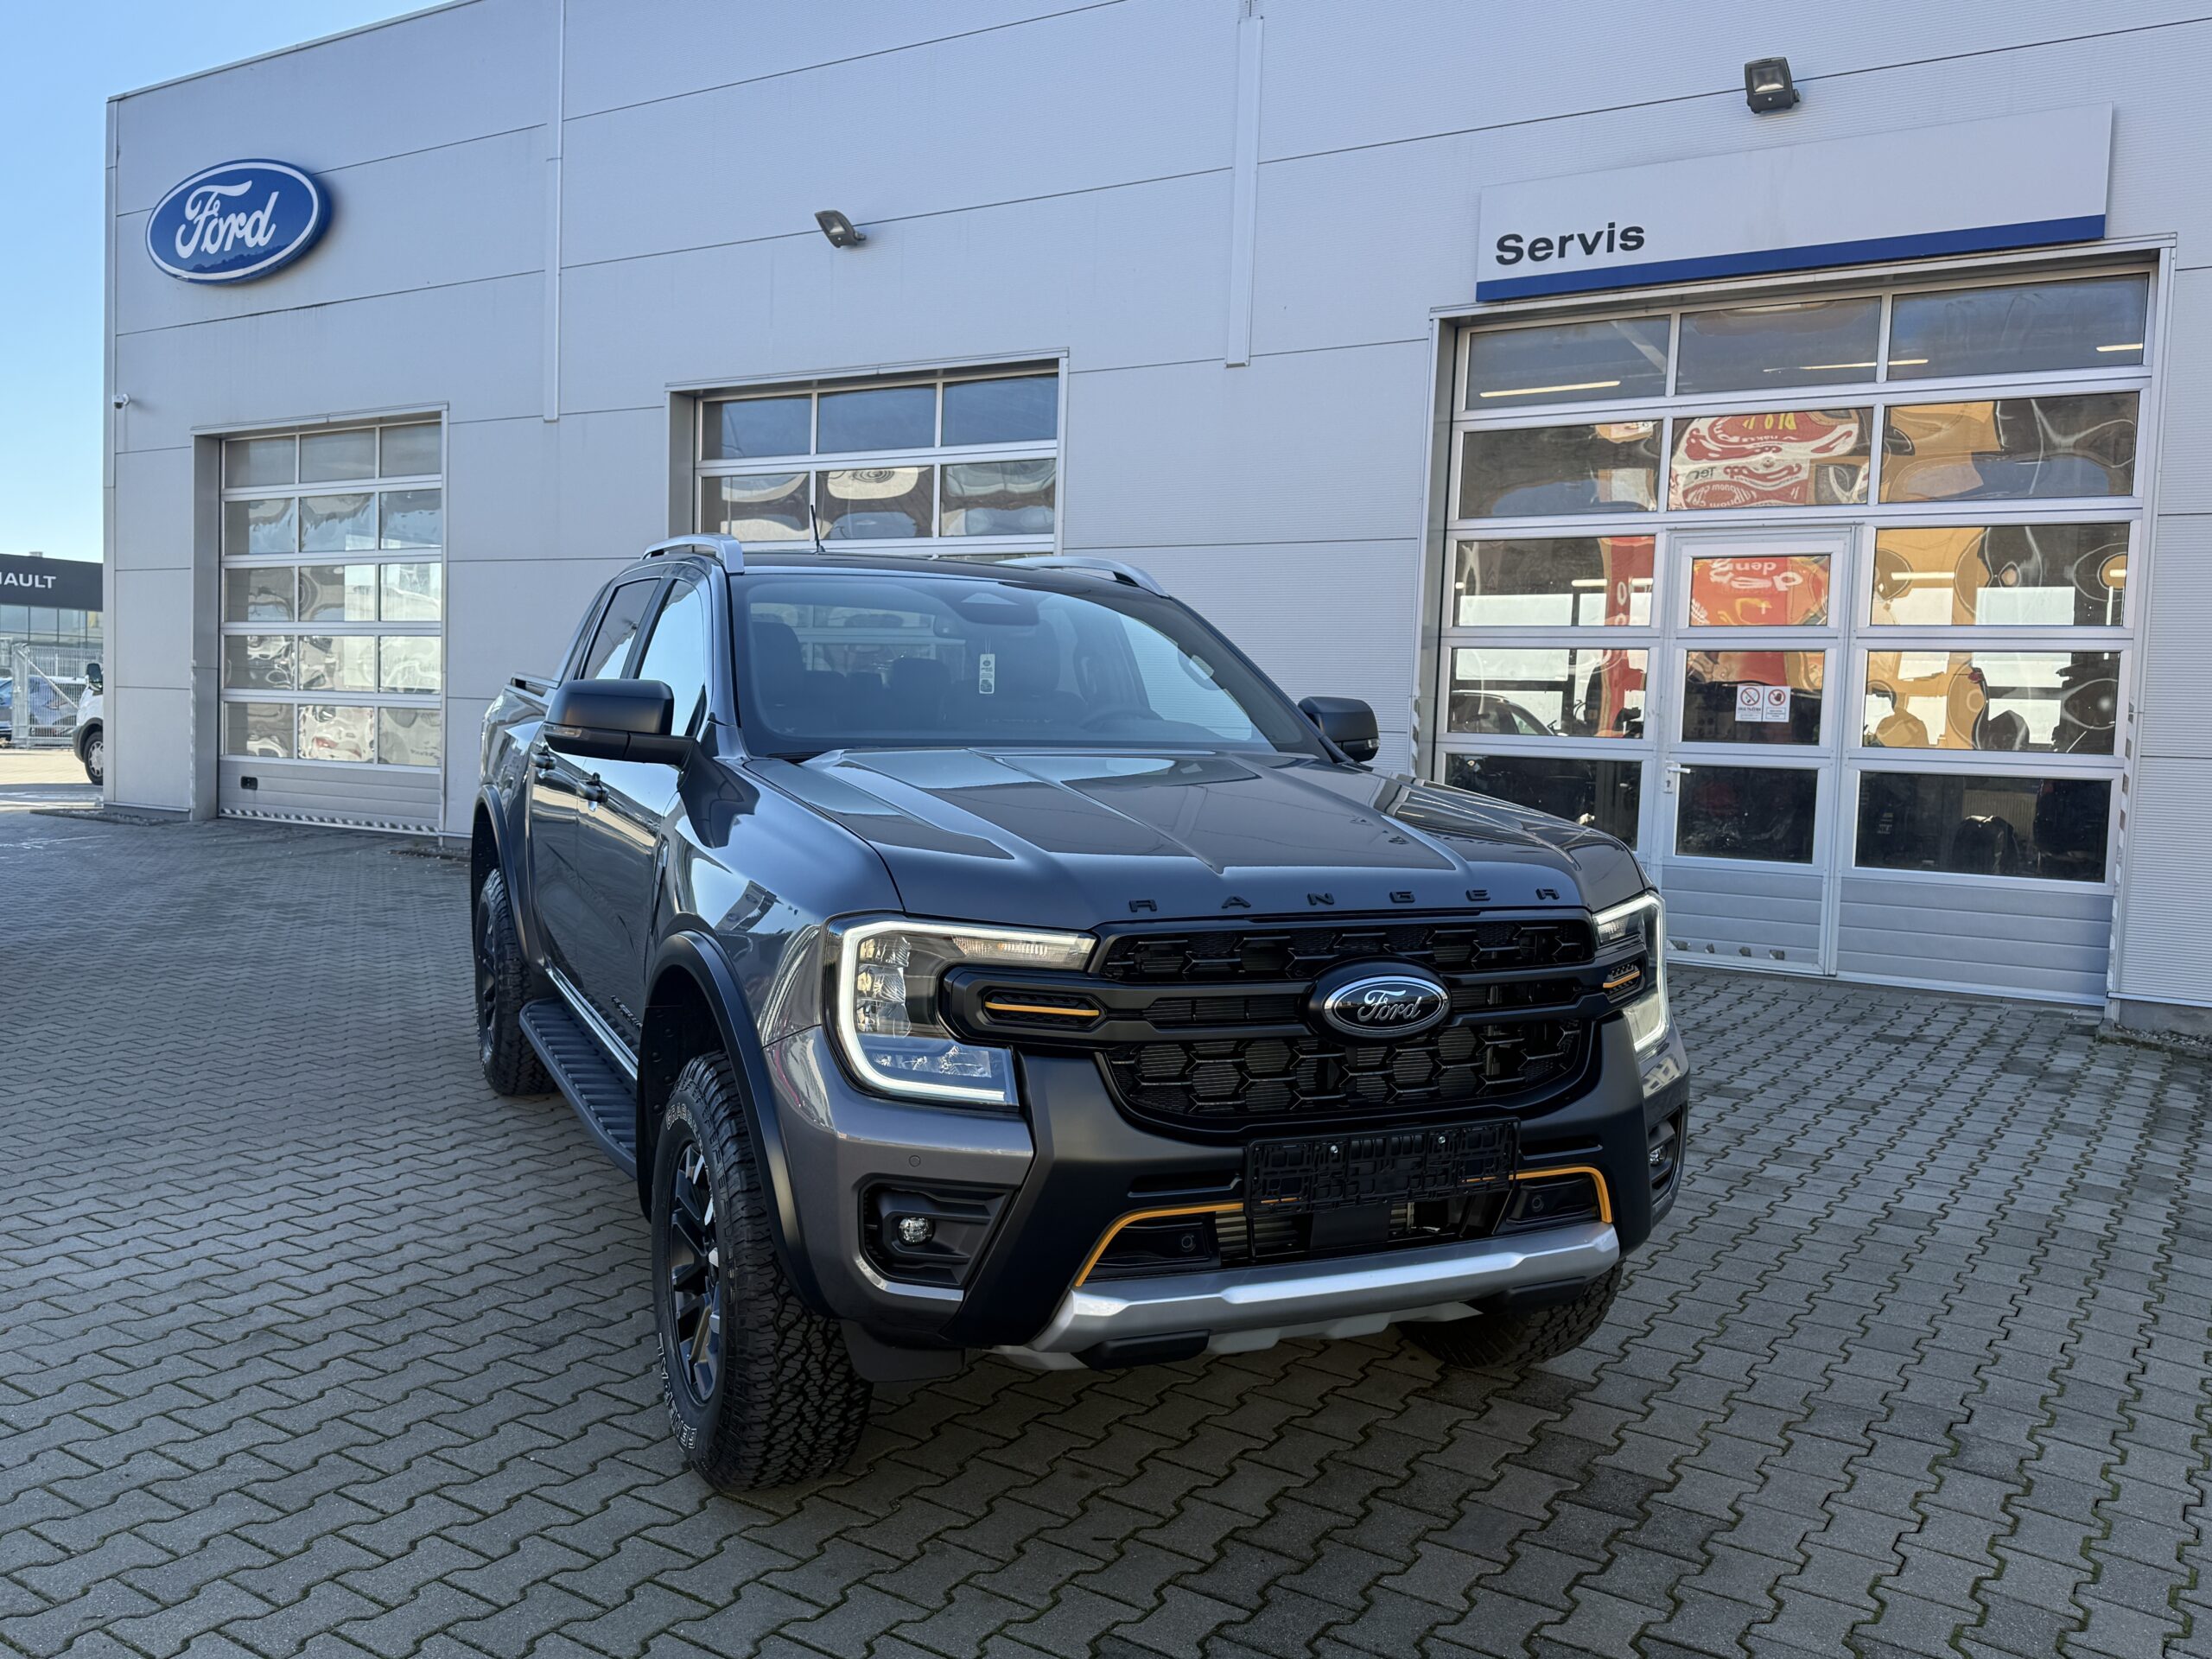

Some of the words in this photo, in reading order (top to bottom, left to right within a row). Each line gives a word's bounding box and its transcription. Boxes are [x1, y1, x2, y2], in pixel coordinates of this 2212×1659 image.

[175, 180, 279, 258] Ford
[1496, 221, 1645, 265] Servis
[0, 572, 56, 588] AULT
[1128, 887, 1560, 912] RANGER
[1357, 989, 1422, 1022] Ford
